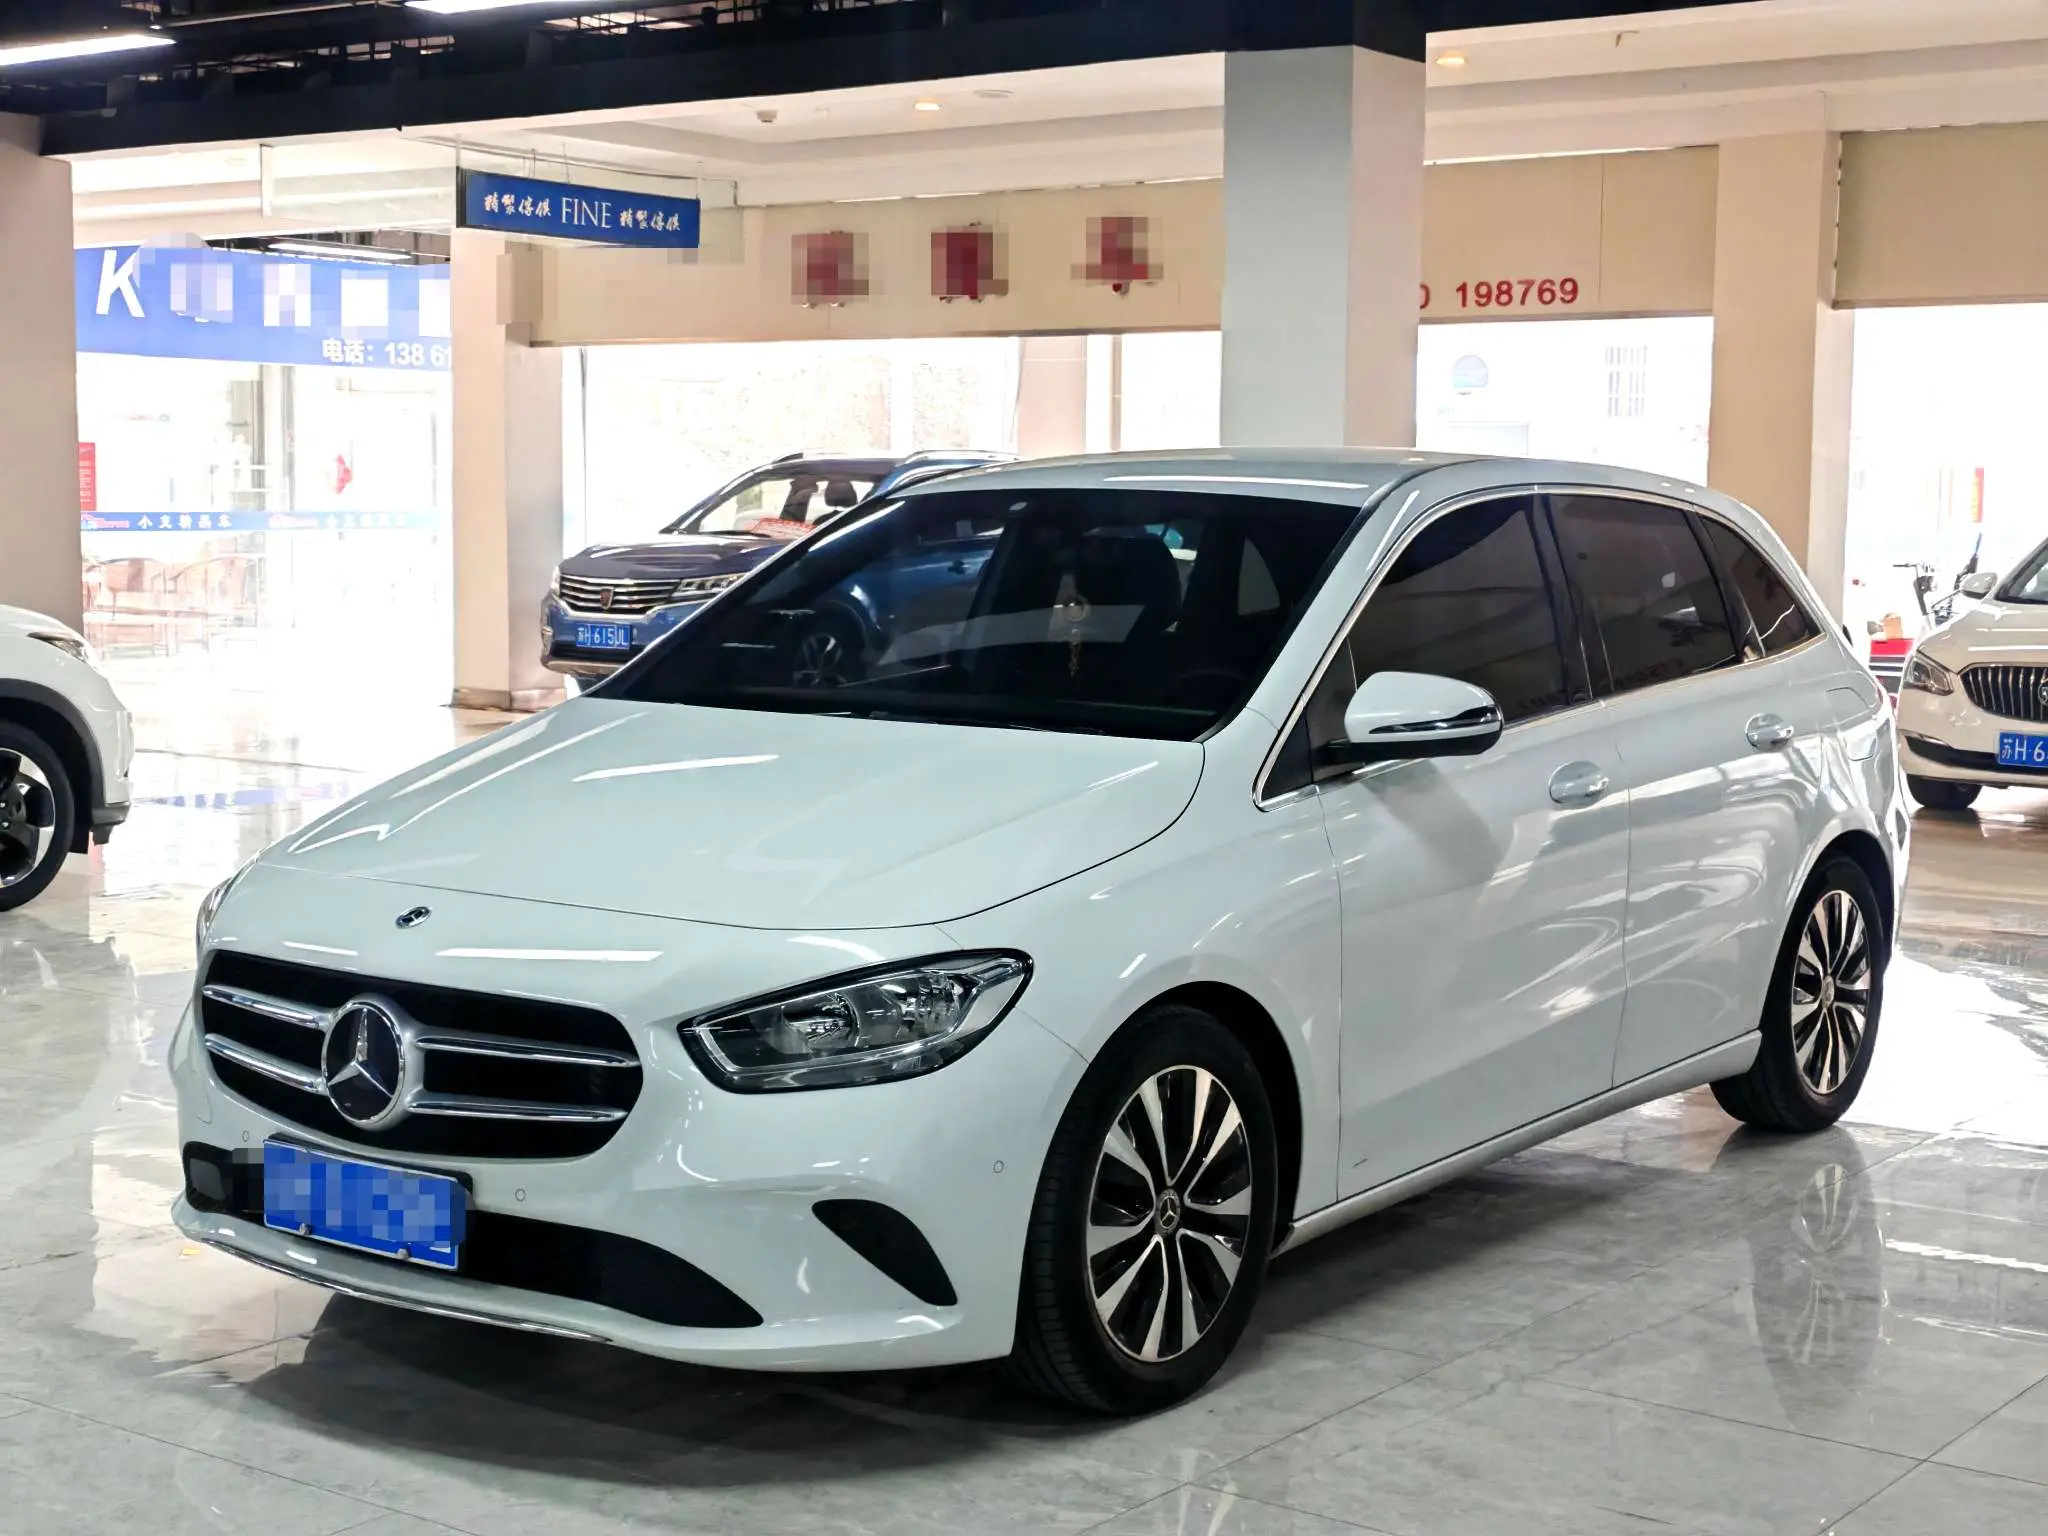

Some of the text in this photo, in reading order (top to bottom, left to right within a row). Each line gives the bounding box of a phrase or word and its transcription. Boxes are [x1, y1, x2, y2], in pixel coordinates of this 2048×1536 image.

[561, 197, 612, 229] FINE
[95, 249, 146, 319] K
[1455, 277, 1579, 308] 198769
[385, 341, 425, 366] 138
[2001, 737, 2048, 763] 苏H·6
